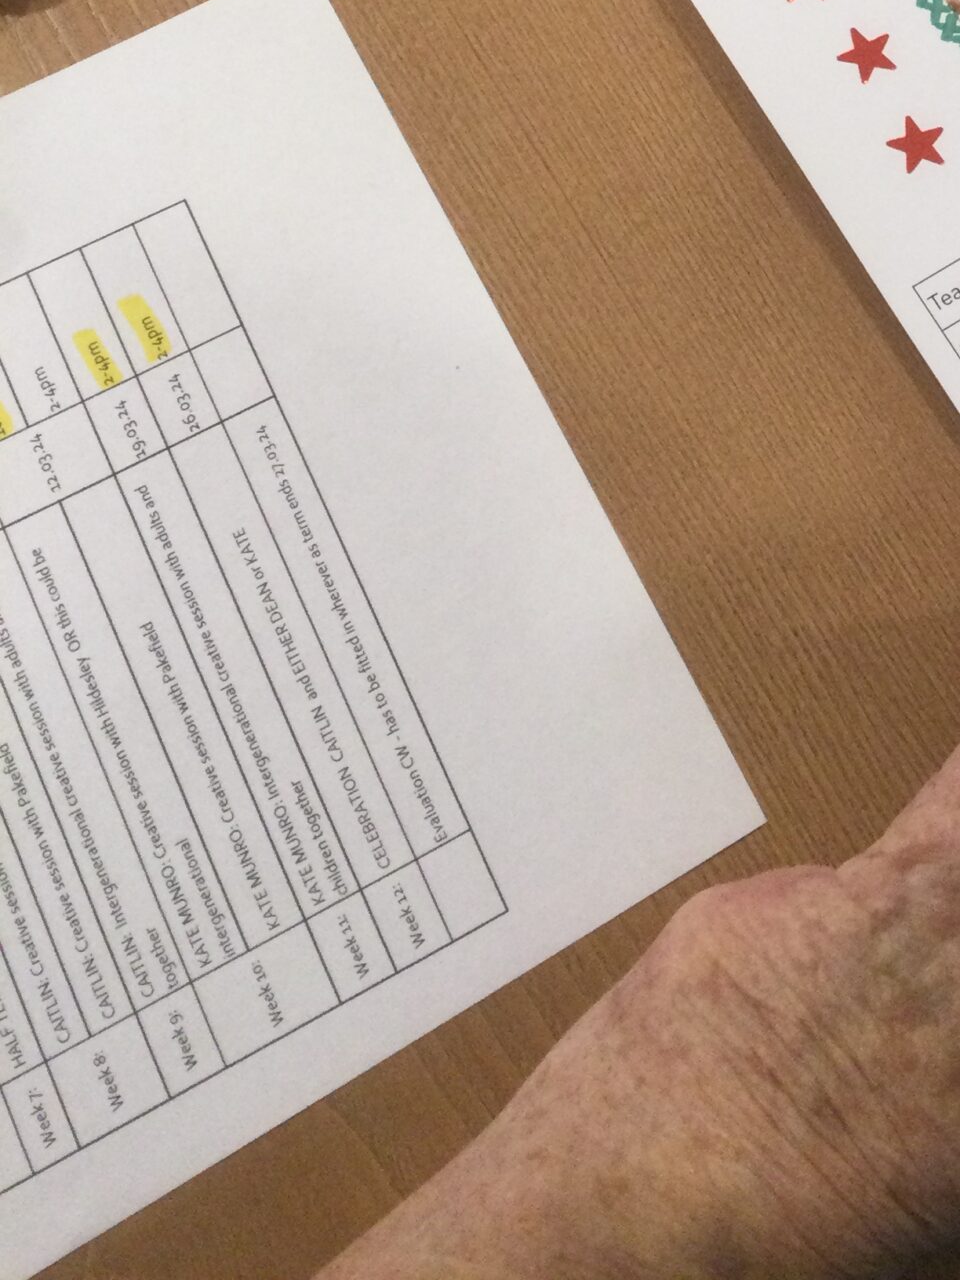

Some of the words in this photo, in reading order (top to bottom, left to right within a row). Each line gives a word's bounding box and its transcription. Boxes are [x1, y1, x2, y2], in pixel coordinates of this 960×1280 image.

[141, 315, 169, 361] 2-4pm
[87, 340, 115, 386] 2-4pm
[34, 366, 61, 413] 2-4pm
[168, 373, 201, 433] 26.03.24
[114, 399, 147, 460] 19.03.24
[255, 424, 286, 478] 27.03.24
[29, 433, 62, 493] 12.03.24
[133, 484, 156, 510] and
[277, 478, 299, 510] ends
[148, 510, 173, 550] adults
[232, 527, 259, 567] KATE
[293, 510, 314, 544] term
[31, 547, 47, 568] be
[164, 550, 186, 581] with
[250, 566, 265, 581] or
[307, 543, 322, 559] as
[35, 566, 61, 602] could
[179, 580, 207, 630] session
[256, 581, 284, 625] DEAN
[315, 561, 349, 621] wherever
[55, 603, 72, 630] this
[343, 620, 356, 635] in
[63, 629, 81, 653] OR
[139, 620, 176, 684] Pakefield
[201, 630, 230, 683] creative
[274, 622, 307, 676] EITHER
[344, 635, 372, 674] fitted
[13, 669, 35, 702] with
[76, 657, 110, 719] Hildesley
[167, 682, 189, 715] with
[295, 674, 318, 701] and
[366, 673, 381, 694] be
[375, 692, 388, 710] to
[28, 701, 57, 752] session
[100, 717, 122, 750] with
[183, 714, 212, 765] session
[219, 682, 280, 801] Intergenerational
[310, 704, 344, 763] CAITLIN
[381, 709, 400, 737] has
[49, 751, 79, 807] creative
[116, 749, 144, 800] session
[394, 745, 415, 770] CW
[204, 764, 235, 824] Creative
[290, 780, 324, 841] together
[409, 769, 448, 844] Evaluation
[23, 807, 45, 840] with
[136, 800, 167, 860] Creative
[273, 799, 308, 865] MUNRO:
[337, 766, 391, 870] CELEBRATION
[38, 839, 66, 892] session
[68, 807, 128, 930] Intergenerational
[228, 826, 263, 889] MUNRO:
[317, 839, 348, 896] children
[160, 862, 195, 926] MUNRO:
[174, 837, 237, 958] intergenerational
[297, 864, 326, 907] KATE
[392, 882, 408, 905] 12:
[59, 892, 89, 953] Creative
[253, 888, 281, 931] KATE
[337, 913, 353, 935] 11:
[399, 905, 426, 950] Week
[14, 916, 45, 977] Creative
[120, 932, 155, 998] CAITLIN:
[145, 927, 179, 990] together
[185, 926, 213, 969] KATE
[343, 935, 370, 980] Week
[81, 952, 116, 1020] CAITLIN:
[251, 959, 267, 983] 10:
[37, 977, 71, 1044] CAITLIN:
[168, 1009, 184, 1026] 9:
[258, 982, 284, 1028] Week
[0, 1027, 27, 1070] HALF
[92, 1050, 107, 1068] 8:
[171, 1026, 198, 1072] Week
[28, 1087, 44, 1103] 7:
[97, 1066, 124, 1113] Week
[30, 1102, 57, 1149] Week
